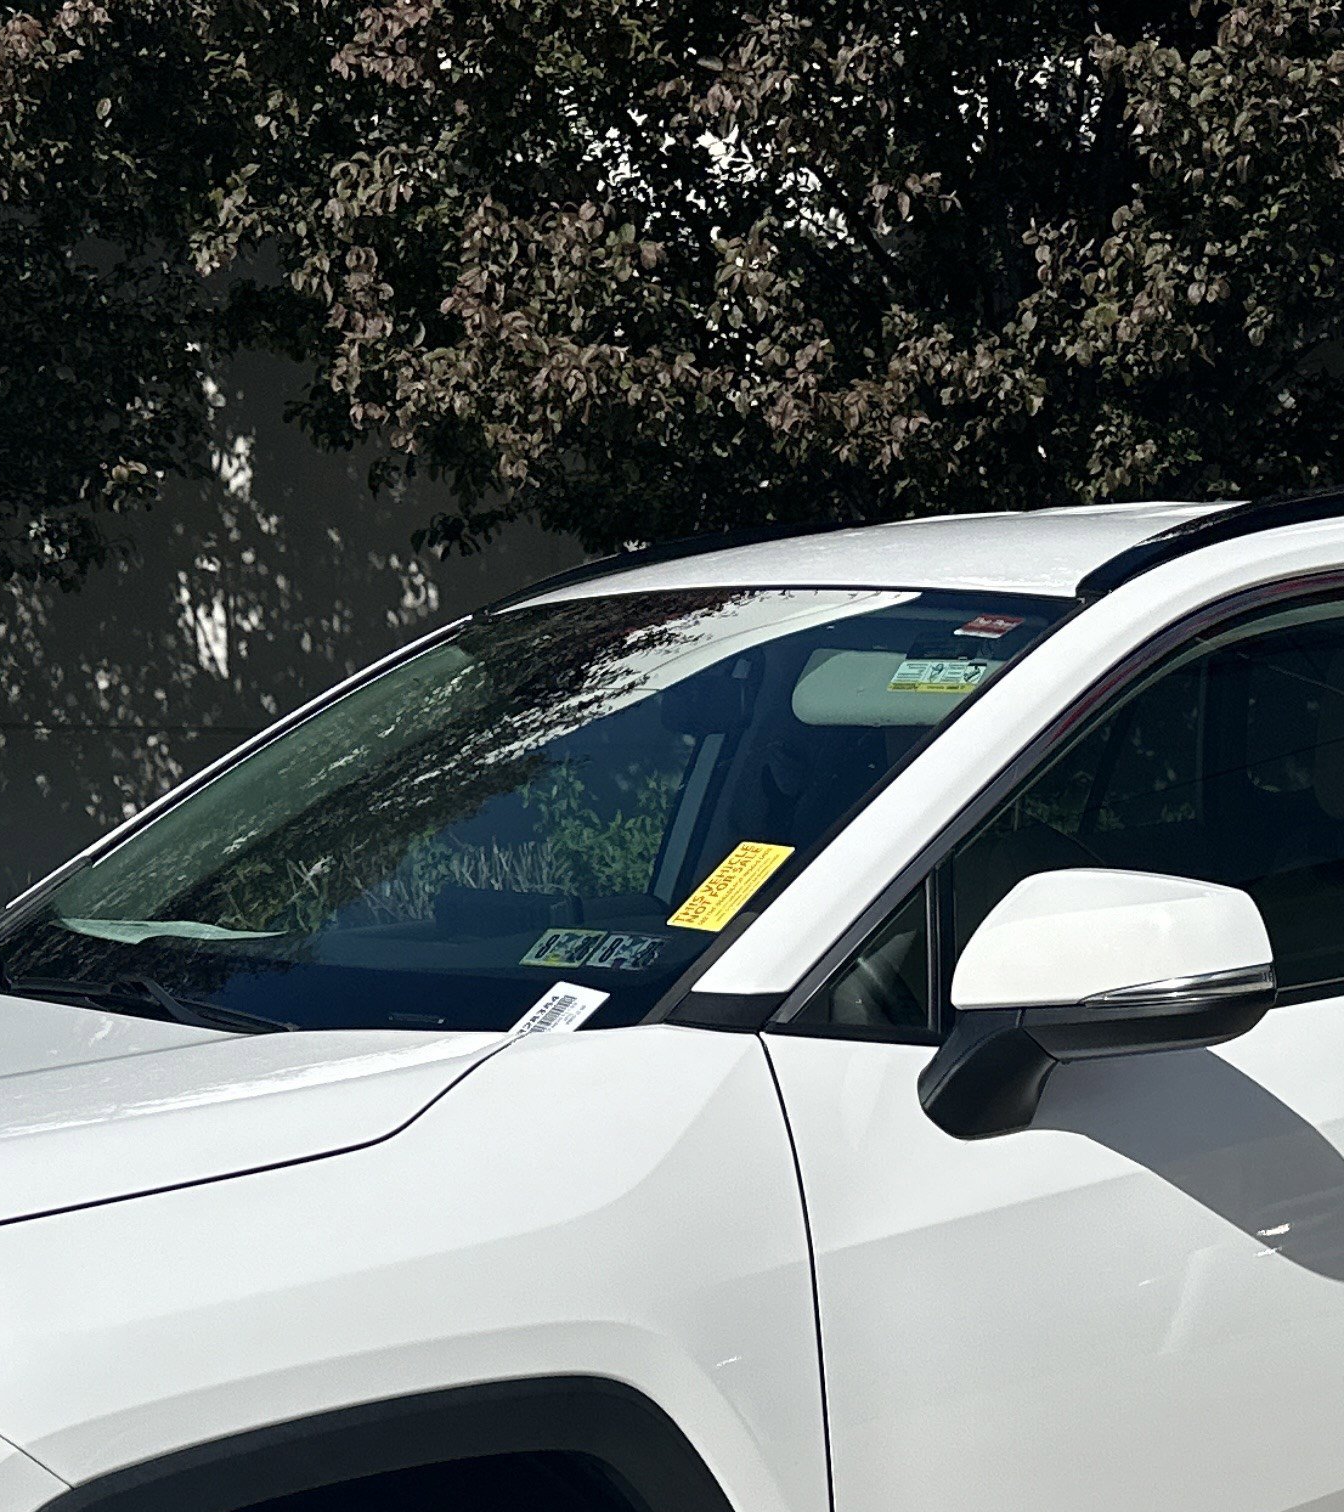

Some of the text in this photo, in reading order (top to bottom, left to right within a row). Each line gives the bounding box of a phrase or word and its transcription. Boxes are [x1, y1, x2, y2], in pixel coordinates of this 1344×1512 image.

[672, 895, 705, 922] THIS
[700, 844, 749, 892] VEHICLE
[684, 900, 711, 923] NOT
[709, 875, 736, 898] FOR
[733, 845, 761, 873] SALE
